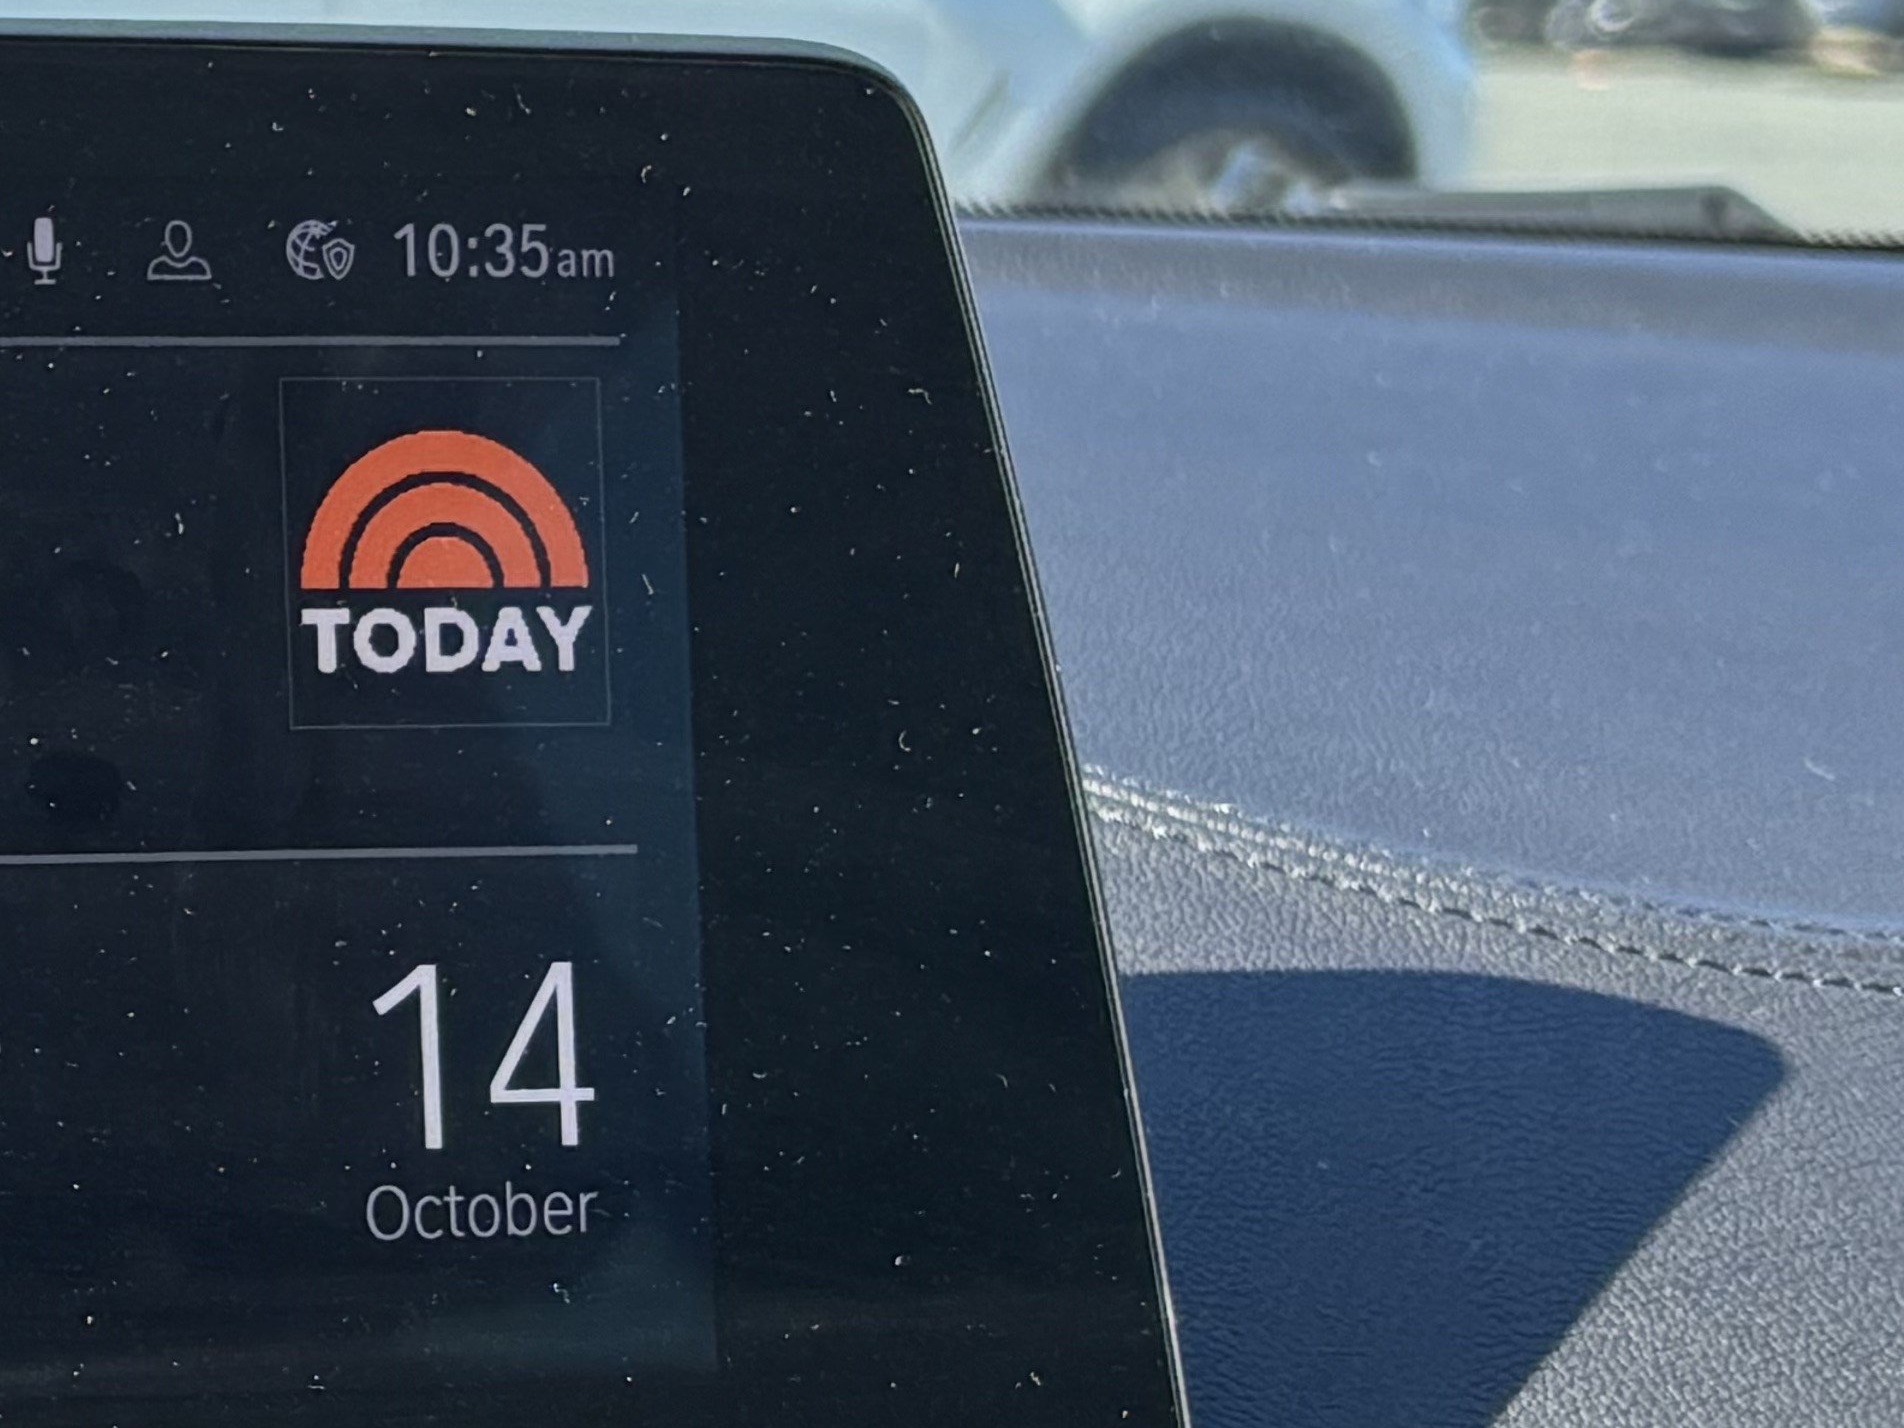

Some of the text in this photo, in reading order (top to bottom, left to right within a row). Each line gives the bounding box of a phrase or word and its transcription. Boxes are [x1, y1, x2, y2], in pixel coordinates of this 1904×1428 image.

[300, 606, 593, 673] TODAY
[372, 961, 595, 1149] 14
[365, 1180, 599, 1241] October
